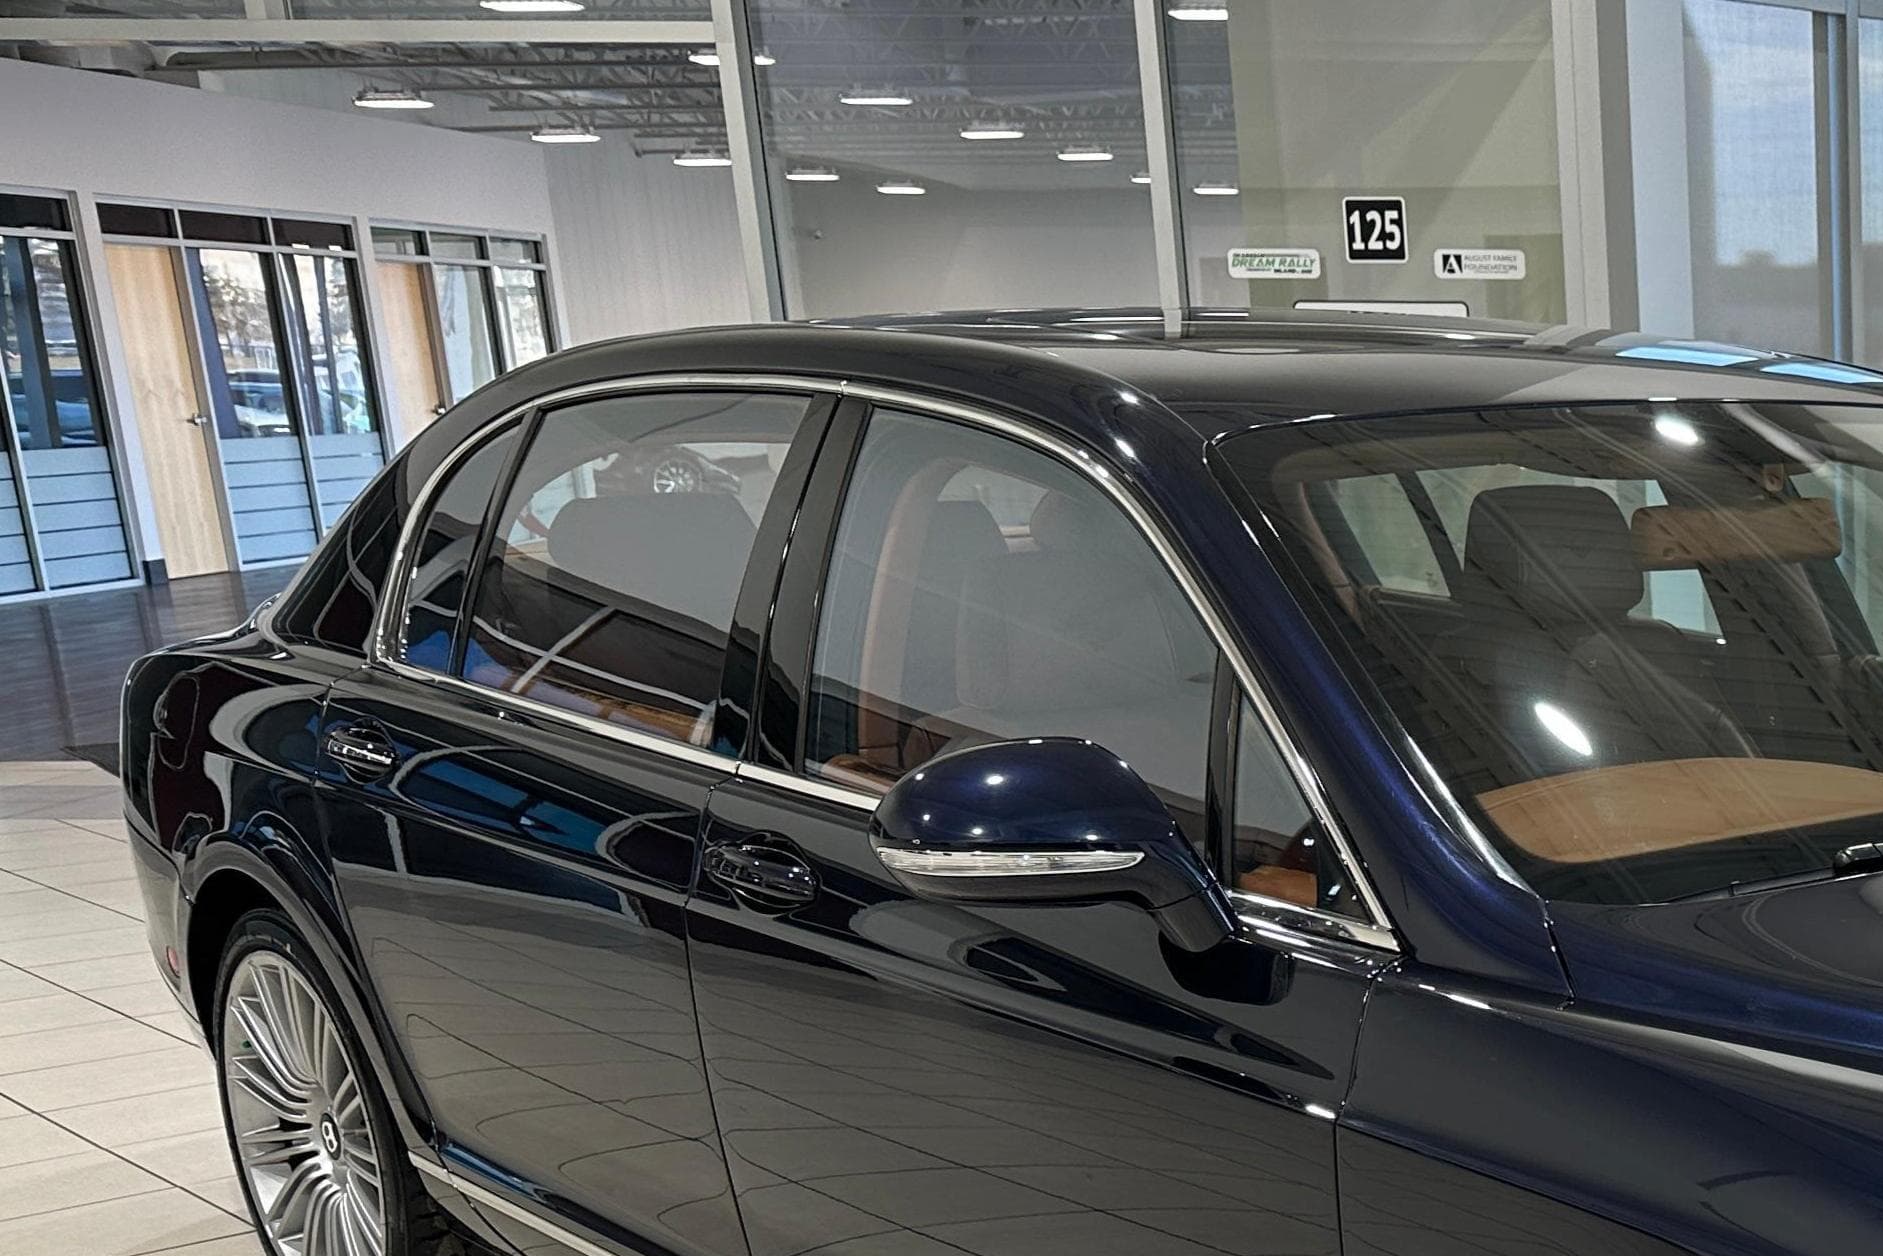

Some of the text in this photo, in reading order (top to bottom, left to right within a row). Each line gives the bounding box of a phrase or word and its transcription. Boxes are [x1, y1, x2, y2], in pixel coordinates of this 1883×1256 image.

[1349, 209, 1401, 250] 125
[1231, 257, 1316, 268] DREAM RALLY
